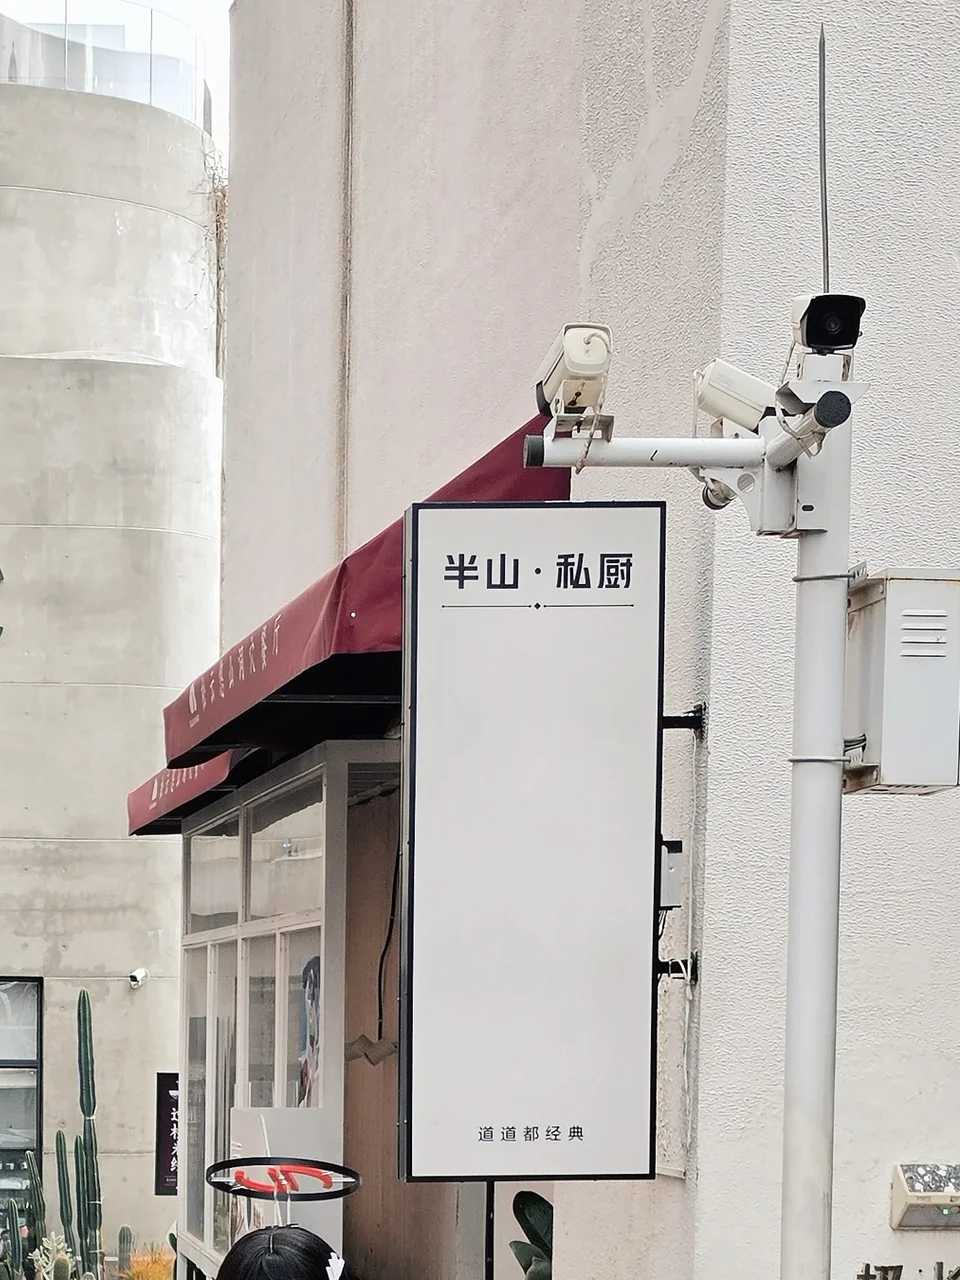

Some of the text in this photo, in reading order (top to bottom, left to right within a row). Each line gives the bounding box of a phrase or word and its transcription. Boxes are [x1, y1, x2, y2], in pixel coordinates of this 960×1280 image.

[443, 552, 633, 590] 半山·私厨
[478, 1125, 584, 1142] 道道都经典
